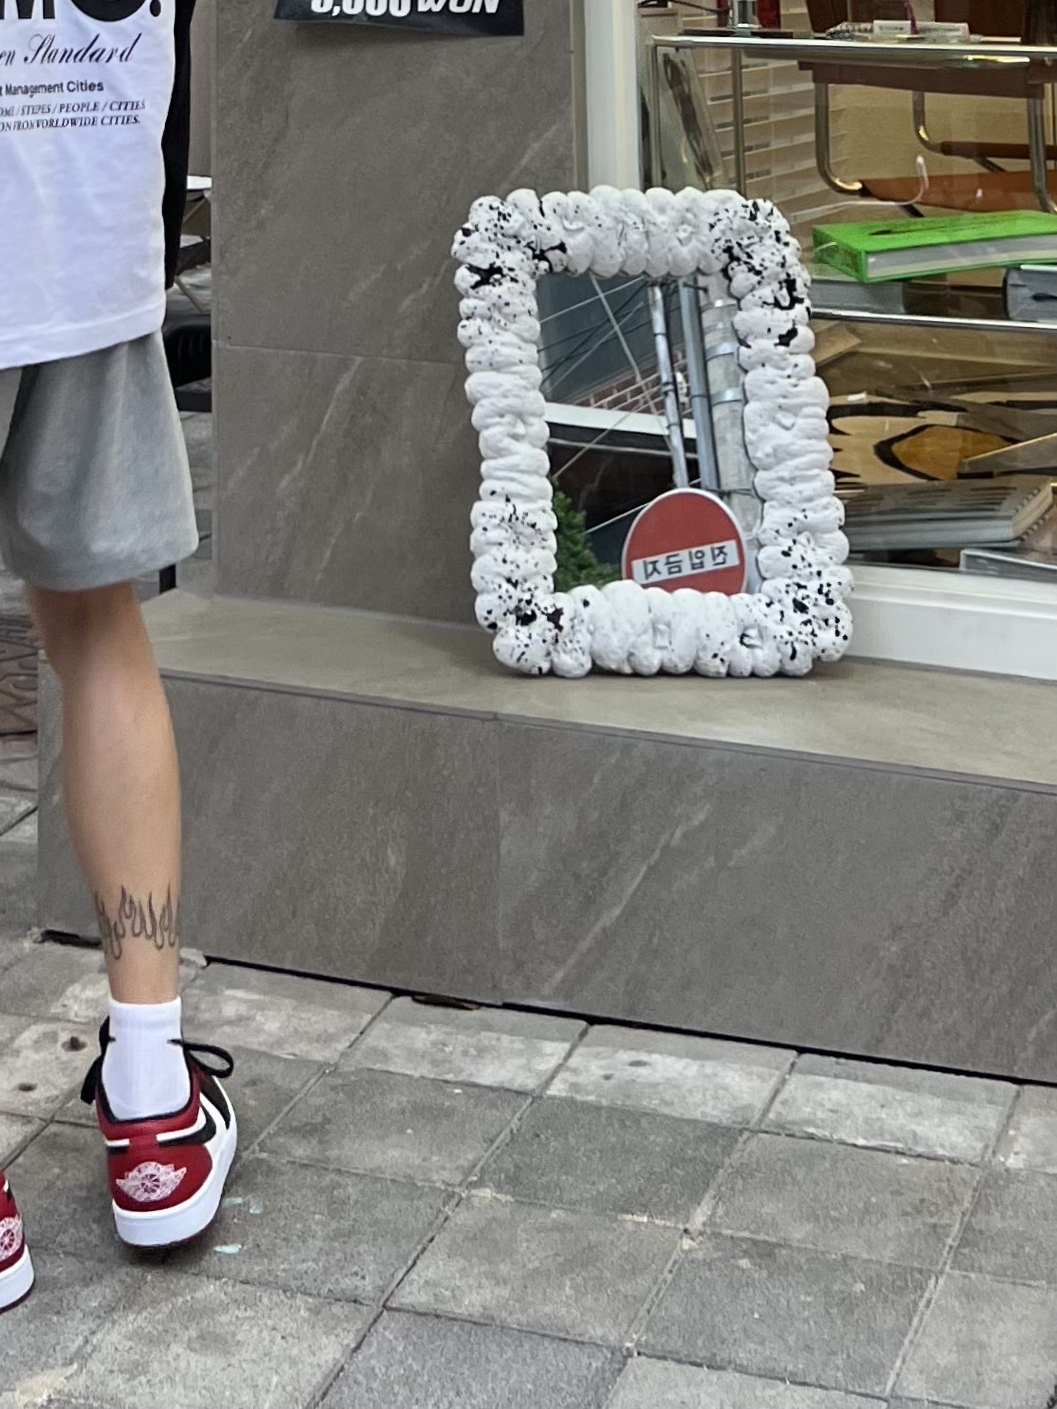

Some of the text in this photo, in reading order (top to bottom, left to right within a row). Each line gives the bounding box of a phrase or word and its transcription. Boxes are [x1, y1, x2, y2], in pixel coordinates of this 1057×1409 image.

[23, 33, 143, 64] Standard
[66, 79, 104, 93] Cities
[59, 101, 100, 115] PEOPLE
[109, 100, 146, 112] CITIES
[100, 114, 142, 127] CITIES.
